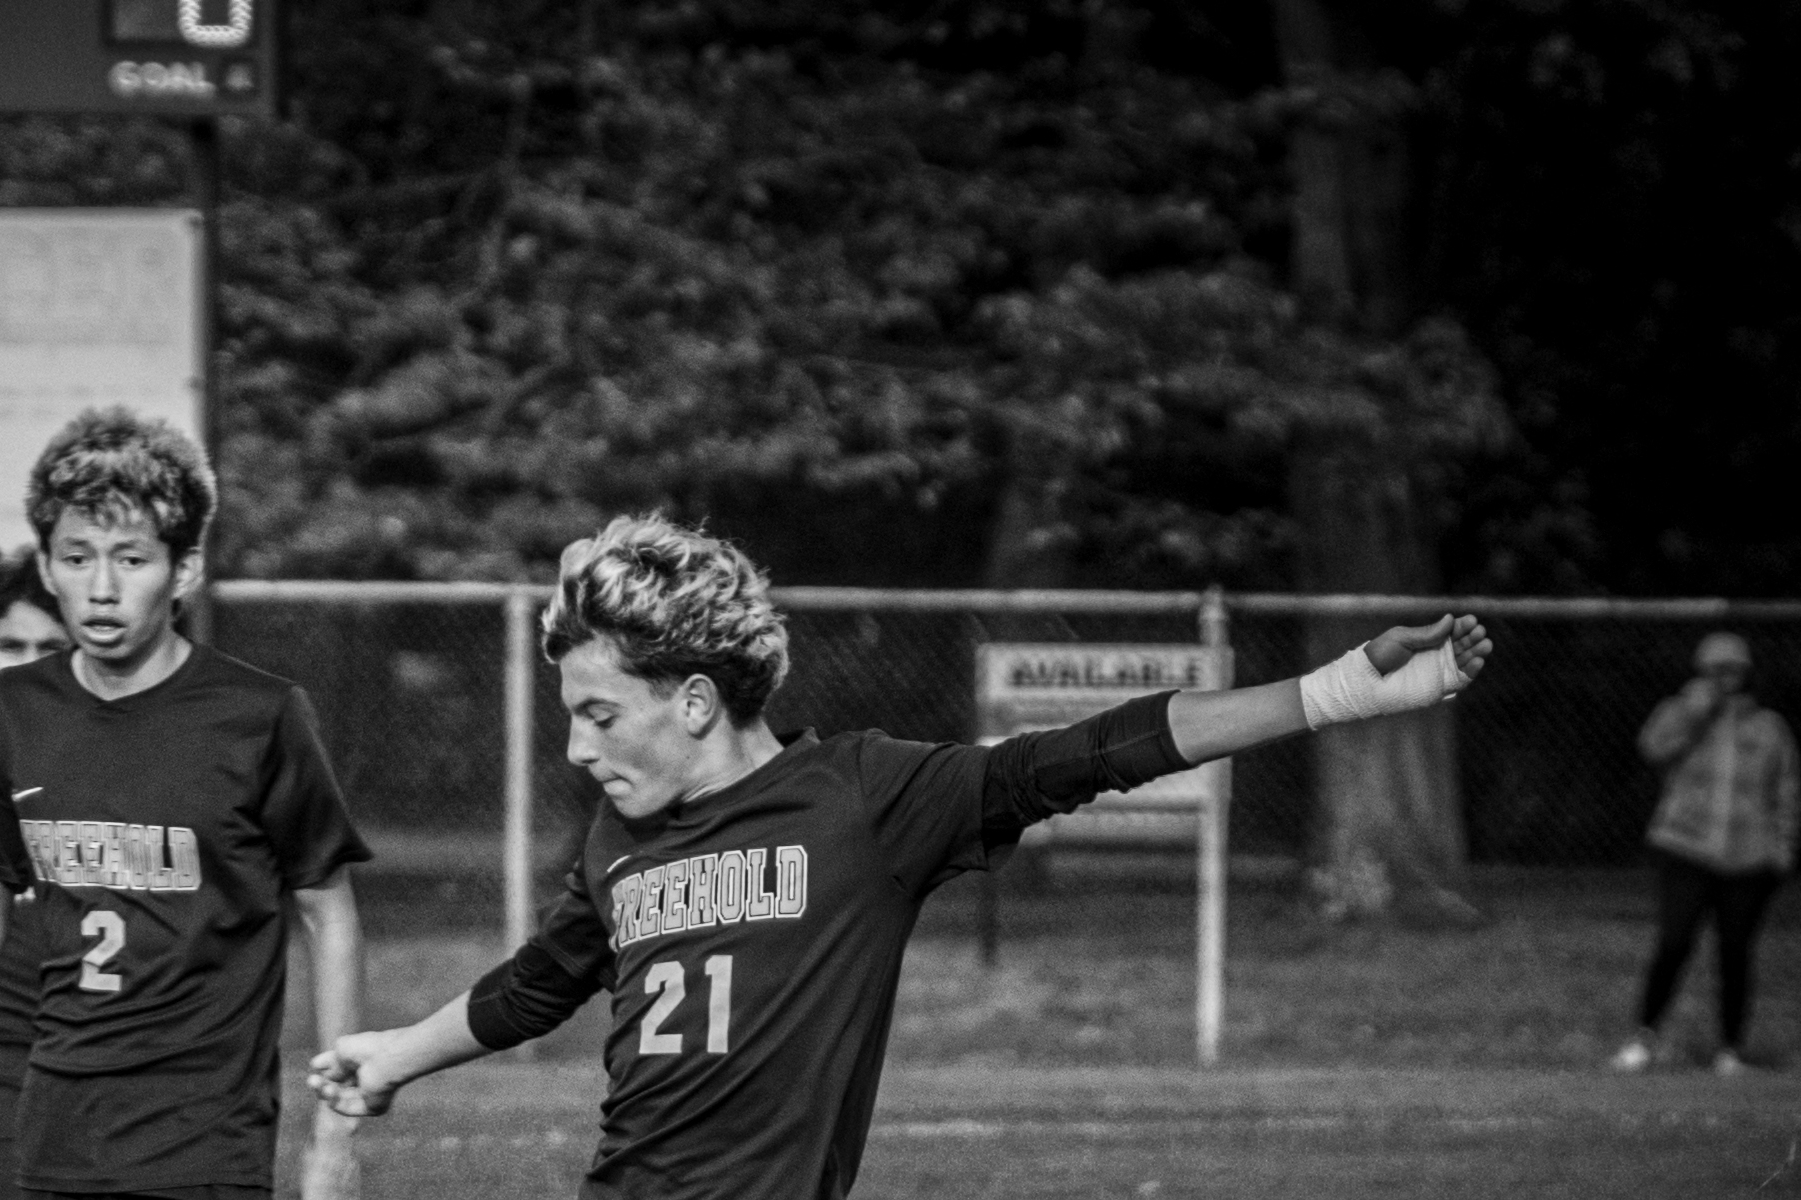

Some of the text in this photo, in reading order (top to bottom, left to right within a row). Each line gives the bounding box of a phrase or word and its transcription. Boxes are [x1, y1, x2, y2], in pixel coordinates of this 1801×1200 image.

[107, 60, 218, 98] GOAL
[78, 910, 127, 992] 2
[638, 954, 733, 1055] 21
